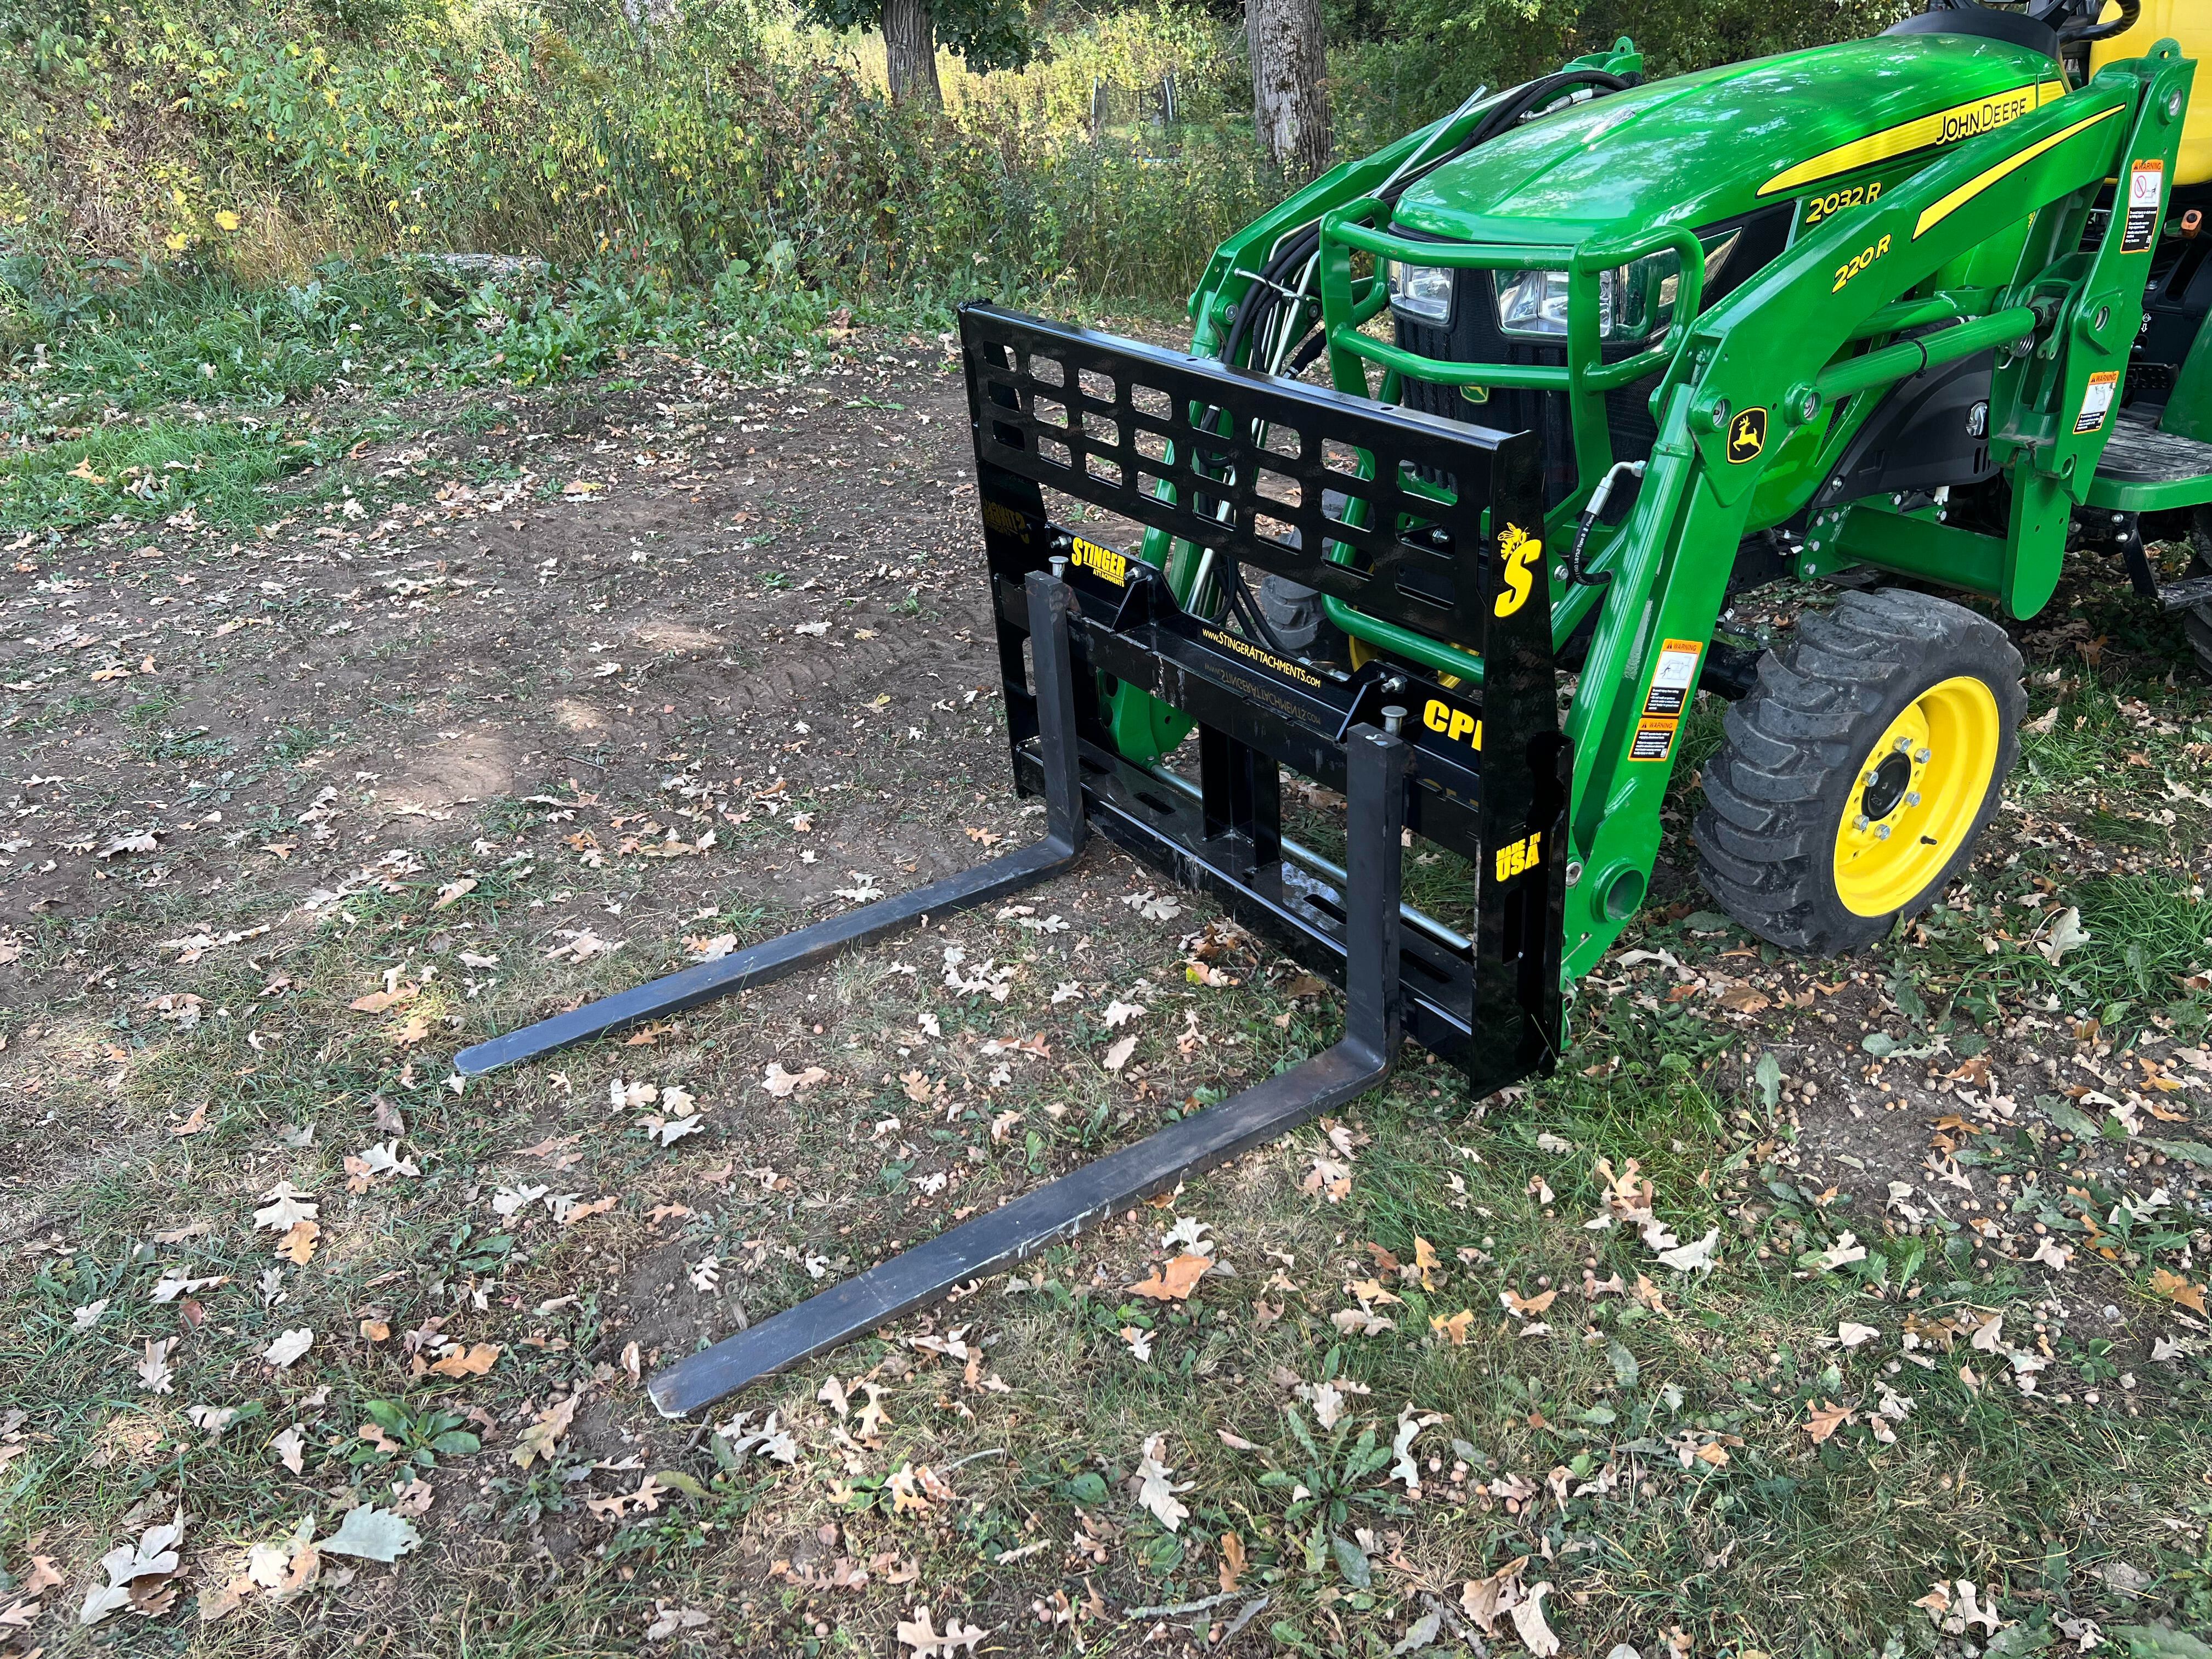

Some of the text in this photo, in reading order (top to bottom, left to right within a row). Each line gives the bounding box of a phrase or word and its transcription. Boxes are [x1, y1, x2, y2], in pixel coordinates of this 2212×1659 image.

[1936, 98, 2027, 143] JOHN DEERE
[2138, 162, 2162, 170] WARNING
[1805, 182, 1882, 225] 2032 R
[1832, 233, 1892, 295] 220 R
[2096, 374, 2117, 382] WARNING
[1071, 537, 1126, 578] STINGER
[1093, 568, 1125, 588] ATTACHMENTS
[1673, 643, 1697, 651] WARNING
[1496, 831, 1541, 861] MADE IN
[1496, 843, 1539, 882] USA
